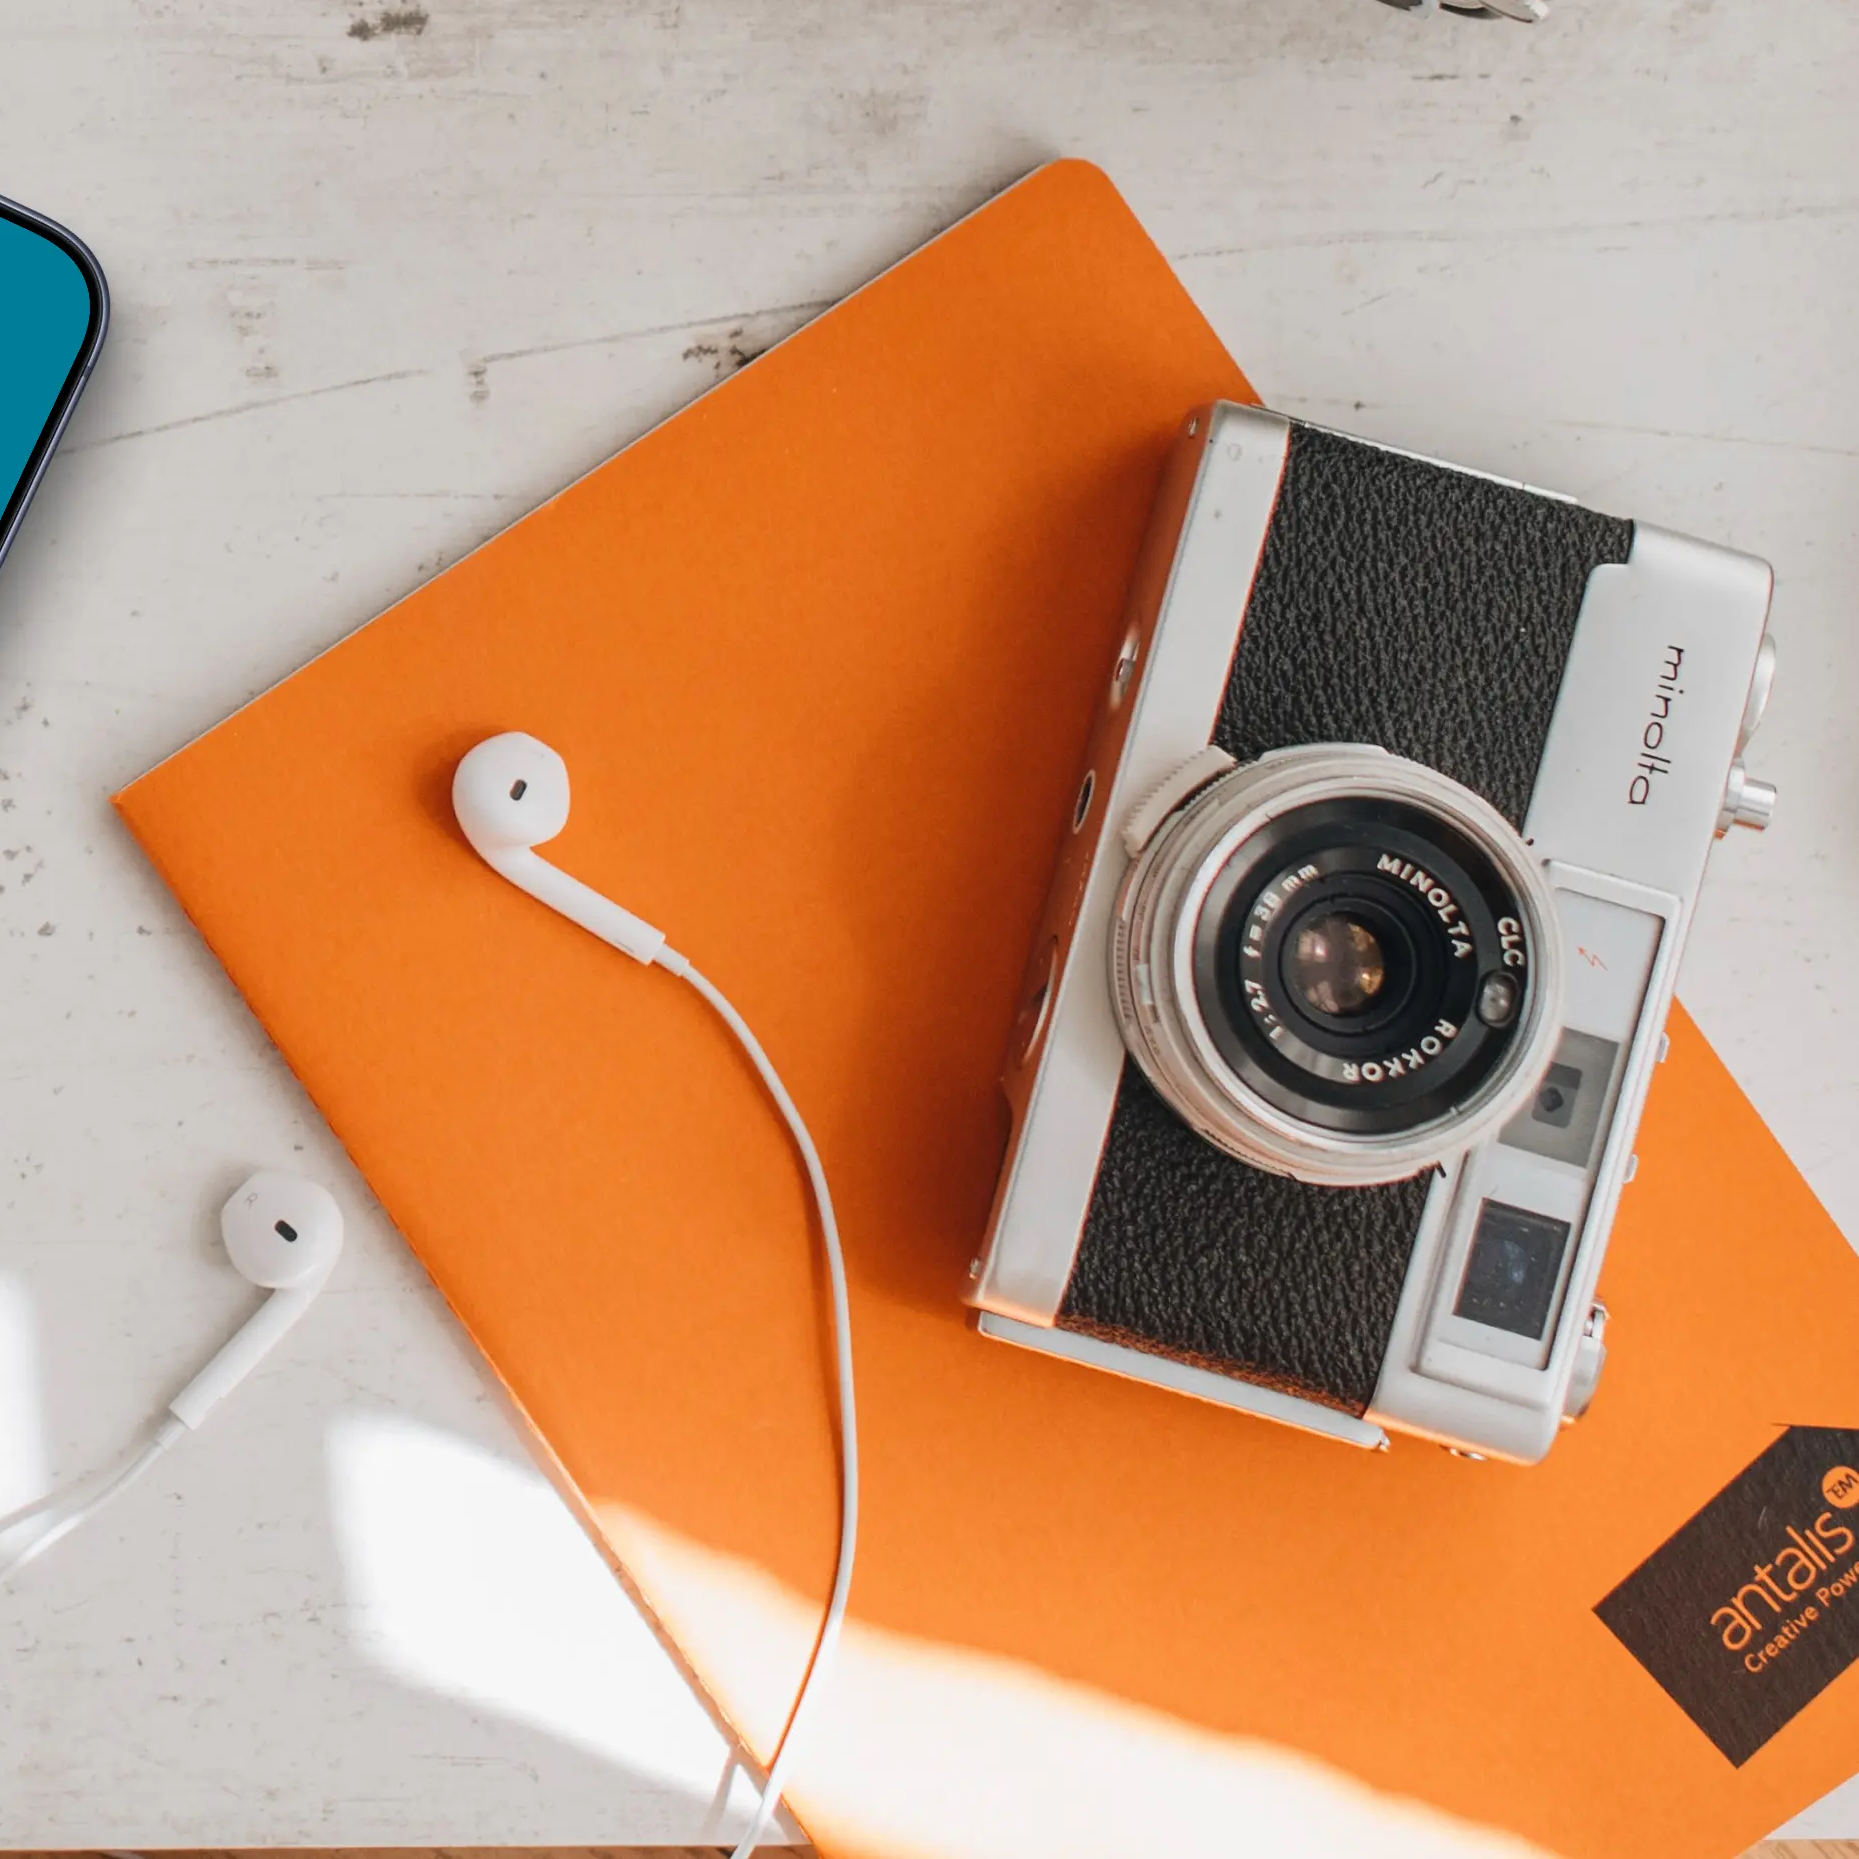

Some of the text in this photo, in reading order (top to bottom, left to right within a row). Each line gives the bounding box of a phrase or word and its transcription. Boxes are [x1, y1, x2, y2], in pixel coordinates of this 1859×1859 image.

[1627, 644, 1685, 805] minolta
[1376, 853, 1475, 960] MINOLTA
[1496, 915, 1526, 968] CLC
[1341, 1018, 1460, 1083] ROKKOR
[1709, 1511, 1854, 1652] antalis
[1743, 1603, 1820, 1674] Creative
